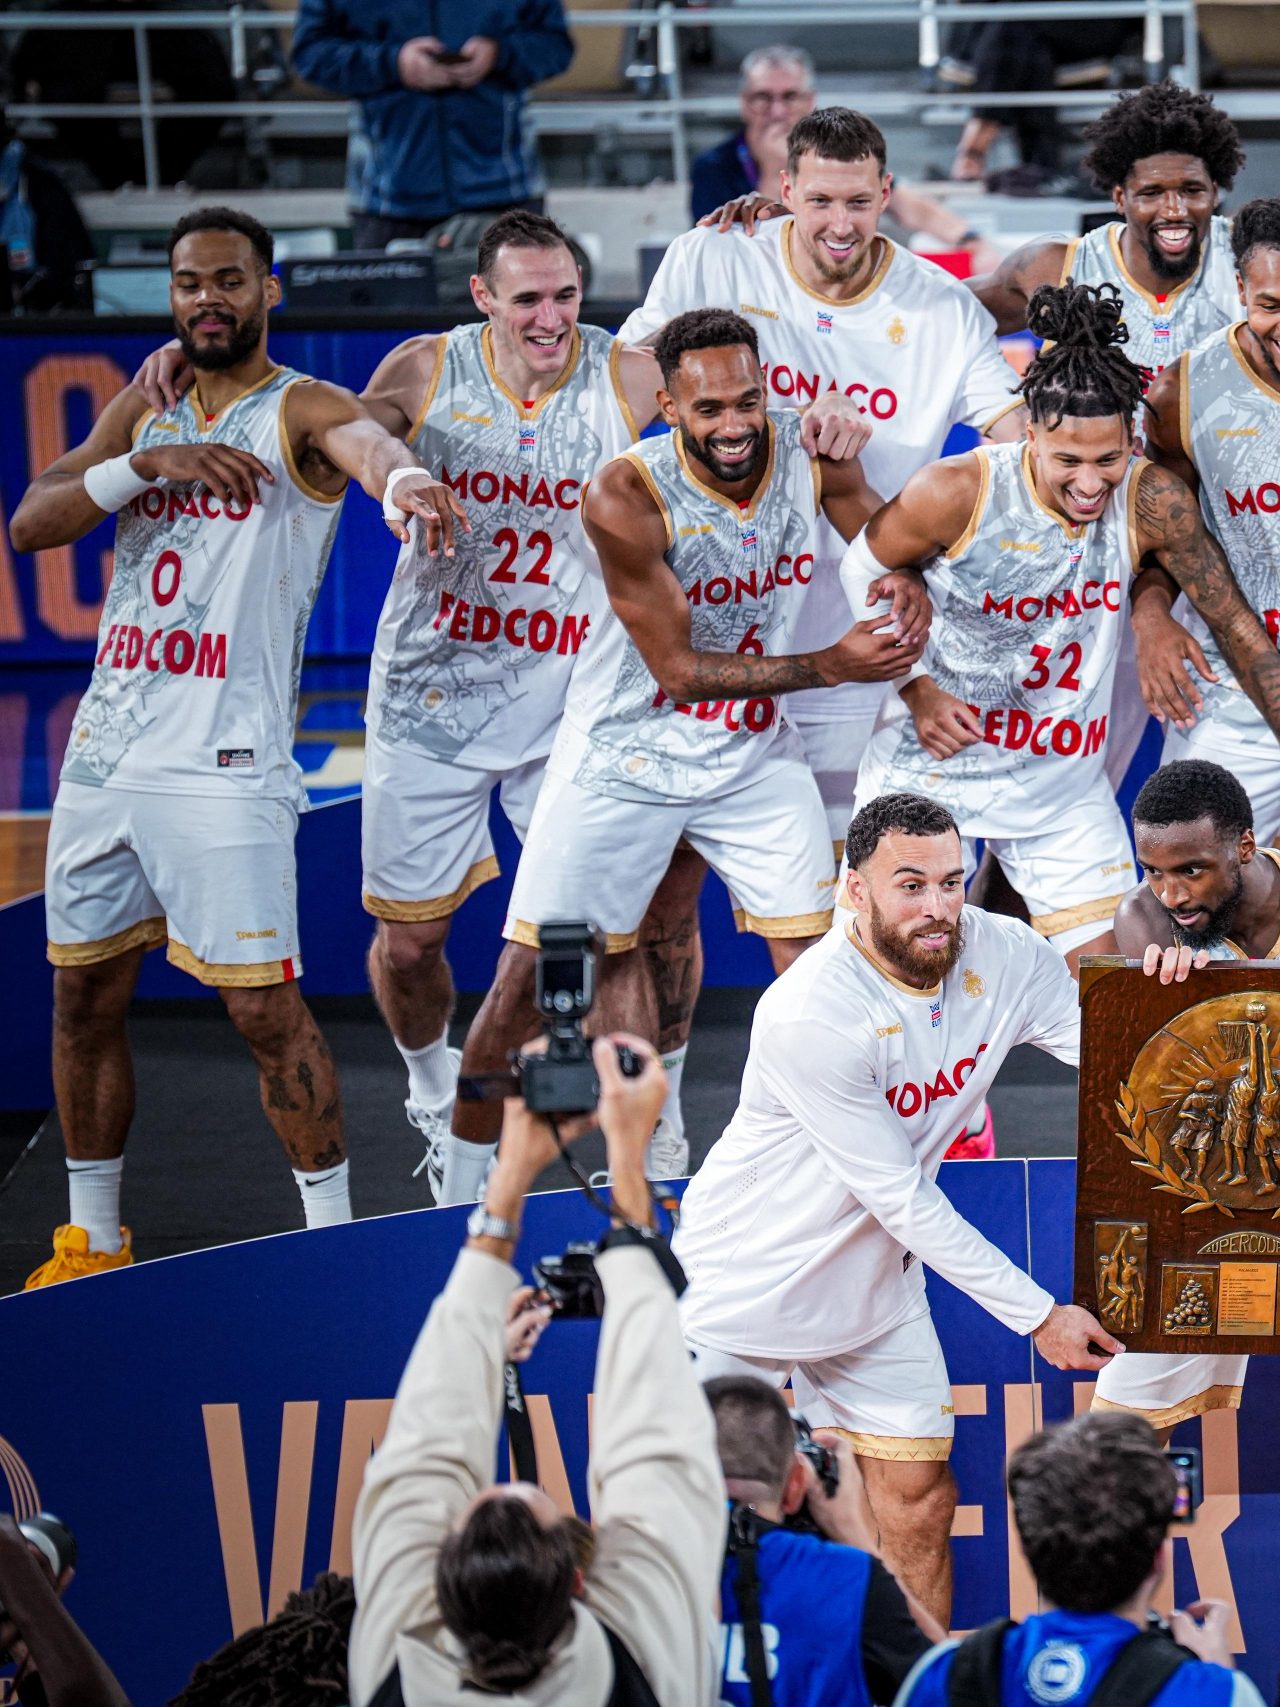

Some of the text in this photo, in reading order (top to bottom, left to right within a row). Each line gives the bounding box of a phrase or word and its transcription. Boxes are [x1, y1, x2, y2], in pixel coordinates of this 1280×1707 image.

[440, 463, 580, 511] MONAC
[151, 550, 183, 607] 0
[487, 527, 554, 586] 22
[981, 580, 1121, 623] MONACO
[1021, 641, 1084, 692] 32
